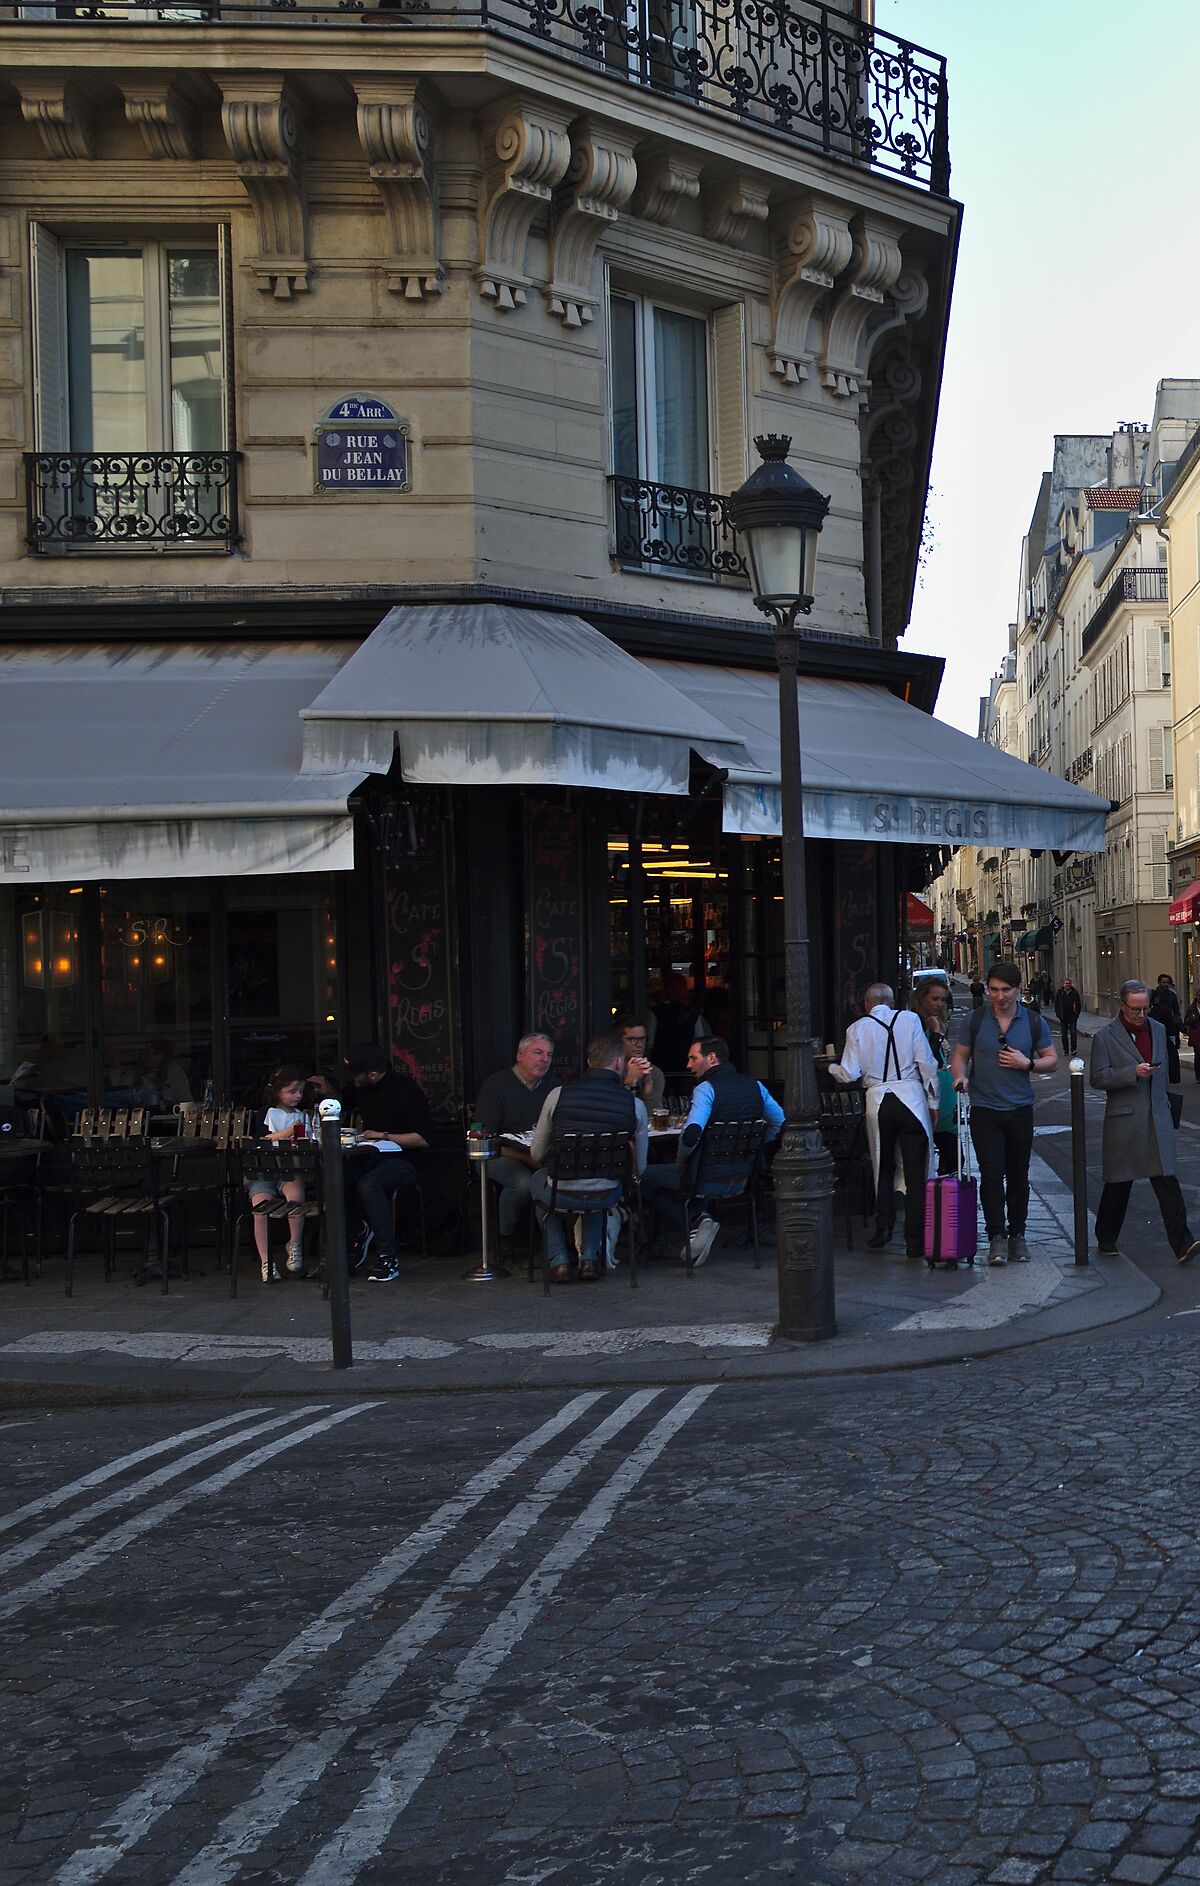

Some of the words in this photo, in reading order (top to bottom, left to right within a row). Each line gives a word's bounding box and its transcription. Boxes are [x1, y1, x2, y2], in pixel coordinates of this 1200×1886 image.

[346, 435, 378, 448] RUE
[344, 452, 383, 464] JEAN
[323, 469, 341, 480] DU
[347, 469, 404, 480] BELLAY
[911, 806, 989, 839] REGIS
